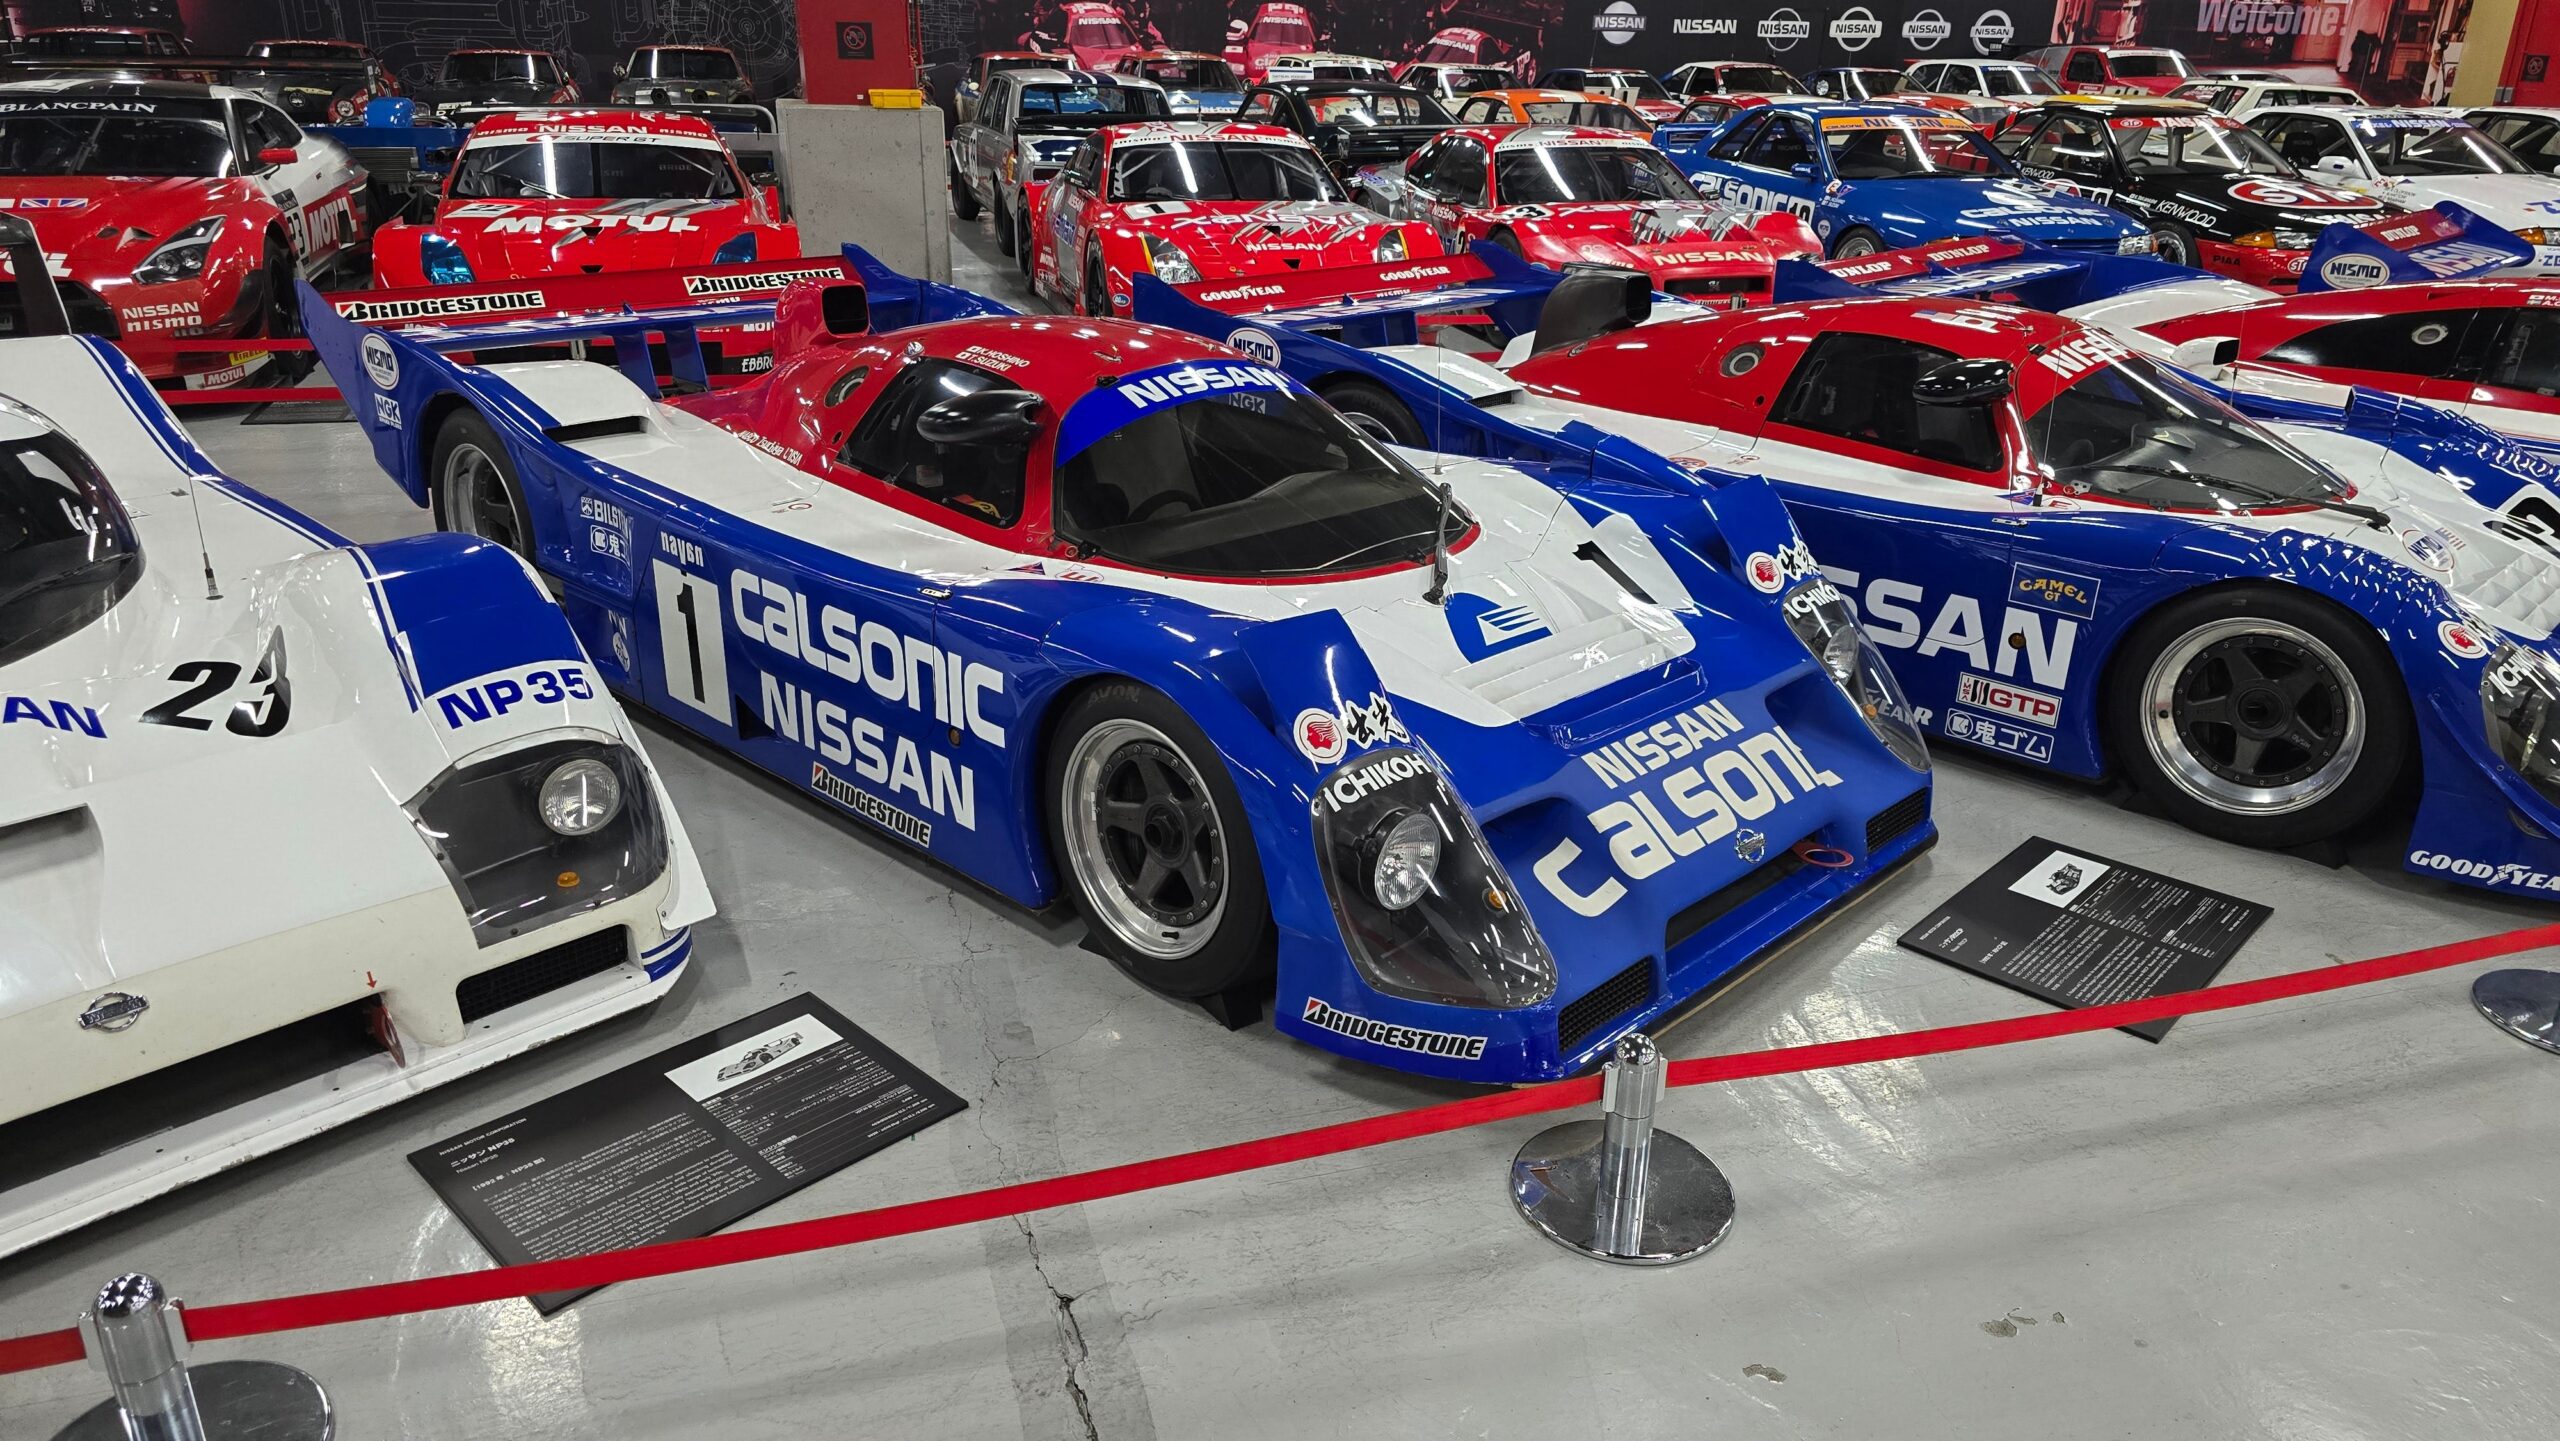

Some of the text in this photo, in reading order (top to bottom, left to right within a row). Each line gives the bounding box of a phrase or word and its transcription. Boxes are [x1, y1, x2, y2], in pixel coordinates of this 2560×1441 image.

[1594, 16, 1645, 31] NISSAN
[1673, 18, 1738, 34] NISSAN
[2198, 0, 2349, 34] Welcome!
[1759, 23, 1808, 37] NISSAN
[1834, 22, 1878, 35] NISSAN
[1907, 22, 1946, 35] NISSAN
[1974, 26, 2013, 38] NISSAN
[0, 101, 158, 114] BLANCPAIN
[539, 124, 648, 134] NISSAN
[1863, 117, 1945, 128] NISSAN
[564, 135, 630, 144] SUPER
[1170, 134, 1258, 142] NISSAN
[1538, 139, 1601, 147] NISSAN
[2009, 216, 2102, 227] NISSAN
[2156, 199, 2216, 229] KENWOOD
[484, 214, 700, 233] MOTUL
[2380, 224, 2420, 242] DUNLOP
[1246, 243, 1323, 252] NISSAN
[1926, 243, 1990, 262] DUNLOP
[1653, 251, 1765, 266] NISSAN
[2212, 254, 2240, 266] PIAA
[1379, 266, 1451, 281] GOODYEAR
[2329, 261, 2382, 279] NISMO
[122, 301, 200, 320] NISSAN
[344, 292, 543, 320] BRIDGESTONE
[127, 315, 202, 333] nismo
[366, 345, 395, 372] NISMO
[1233, 337, 1274, 362] NISMO
[207, 367, 245, 385] MOTUL
[1118, 364, 1288, 409] NISSAN
[376, 397, 400, 421] NGK
[1572, 539, 1659, 605] 1
[1783, 579, 1840, 619] ICHIKO
[2018, 578, 2088, 605] CAMEL
[2044, 590, 2062, 603] GT
[677, 582, 706, 704] 1
[437, 668, 594, 730] NP35
[1988, 687, 2057, 717] GTP
[1580, 697, 1744, 789] NISSAN
[1972, 720, 2047, 759] 鬼ゴム
[760, 670, 976, 833] NISSAN
[1324, 752, 1432, 813] ICHIKOH
[812, 763, 931, 847] BRIDGESTONE
[1304, 999, 1485, 1060] BRIDGESTONE
